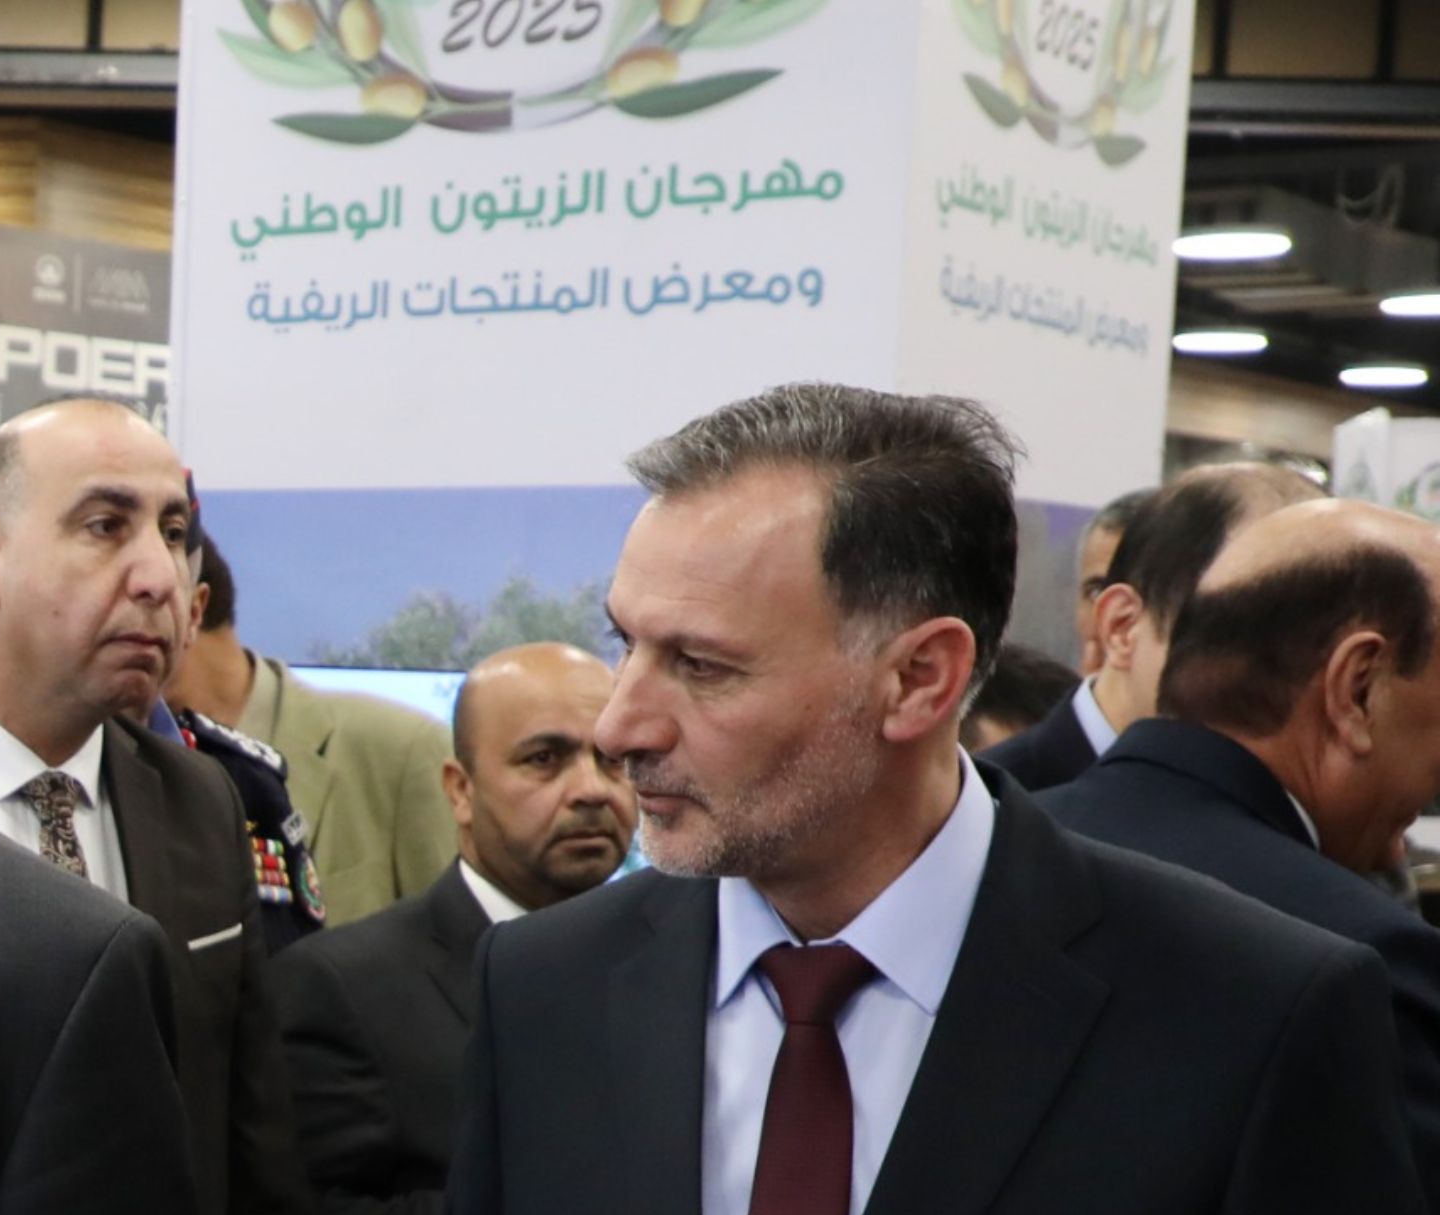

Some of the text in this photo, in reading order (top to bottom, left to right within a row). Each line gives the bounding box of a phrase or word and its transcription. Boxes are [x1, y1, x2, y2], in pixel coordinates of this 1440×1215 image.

[442, 0, 602, 52] 2025
[230, 157, 844, 262] مهرجان الزيتون الوطني
[247, 262, 824, 334] ومعرض المنتجات الريفية
